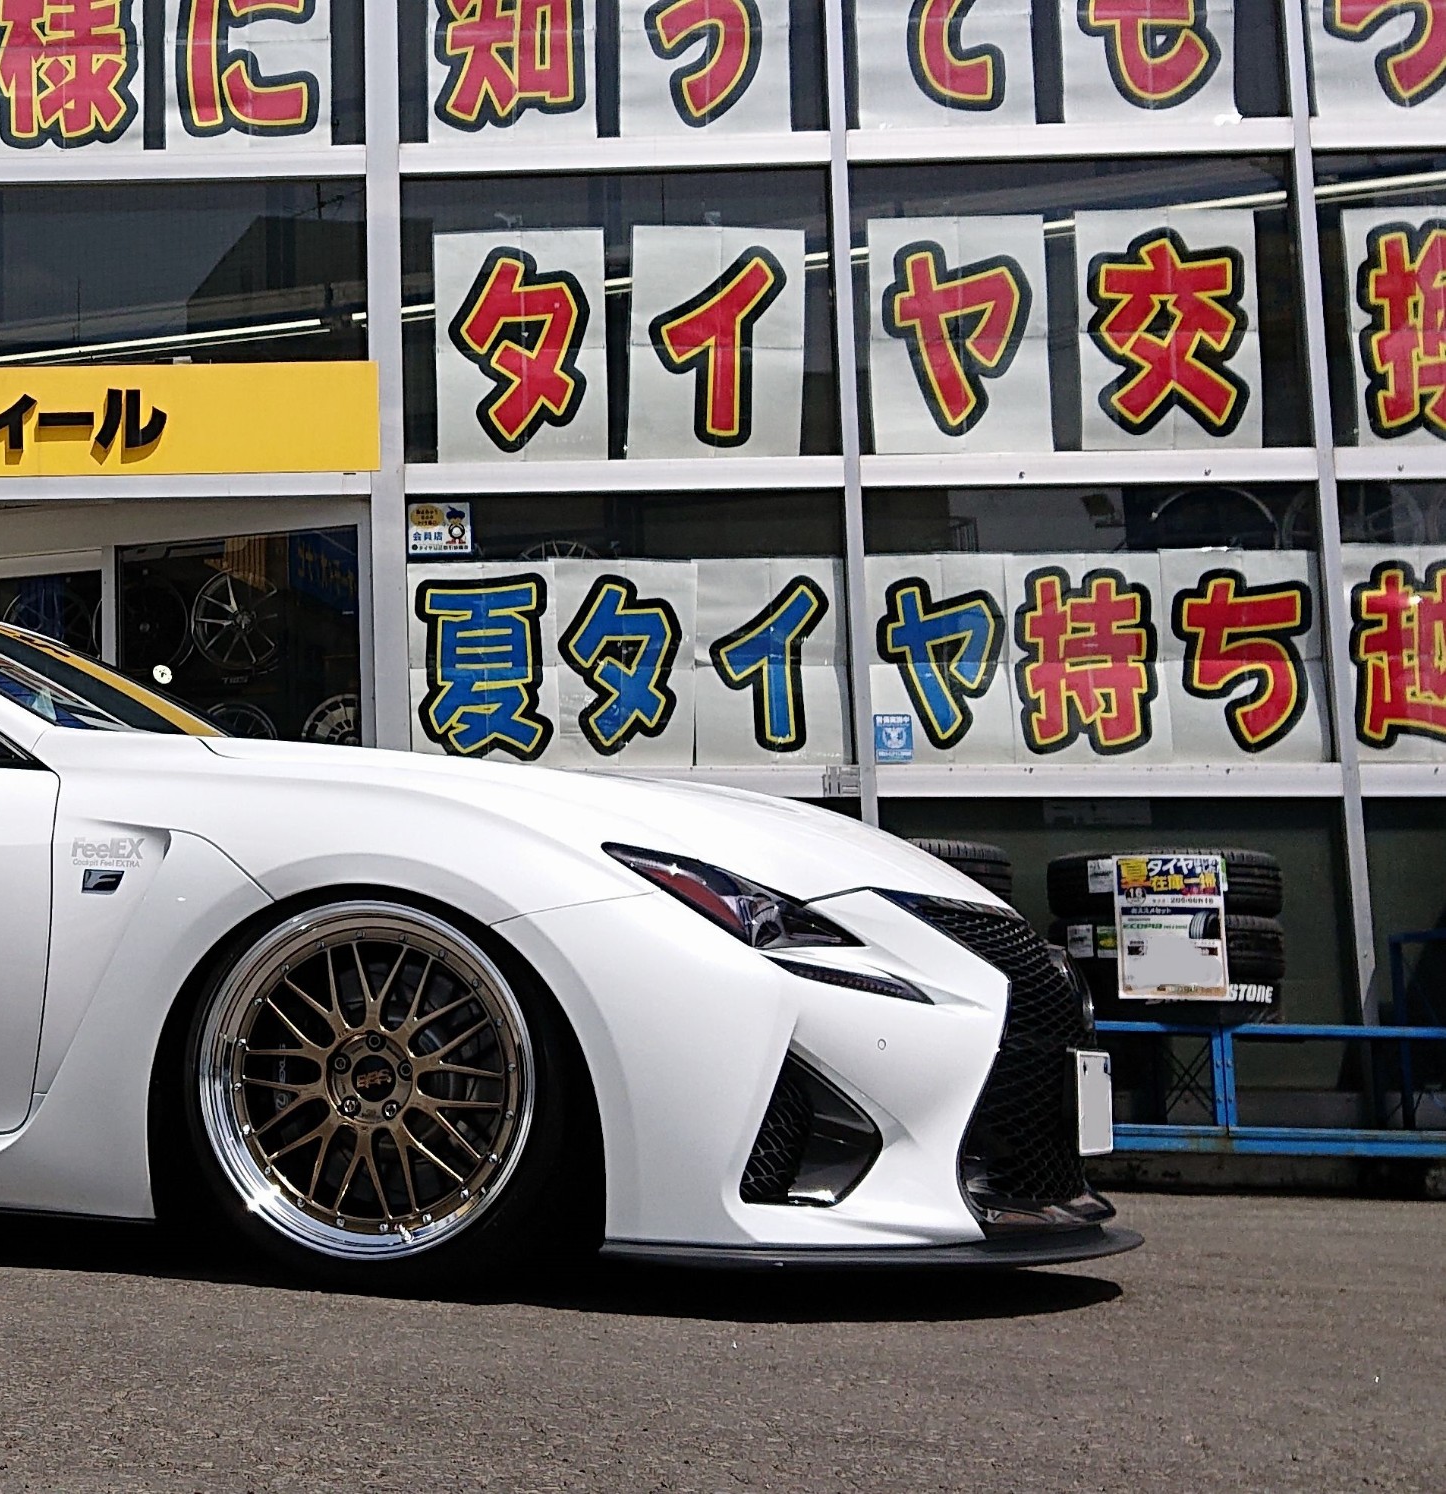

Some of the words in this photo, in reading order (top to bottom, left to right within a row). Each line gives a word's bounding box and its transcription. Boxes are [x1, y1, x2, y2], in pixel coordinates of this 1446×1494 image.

[71, 837, 146, 860] FeelEX
[72, 858, 99, 867] Cockpit
[115, 860, 141, 868] EXTRA
